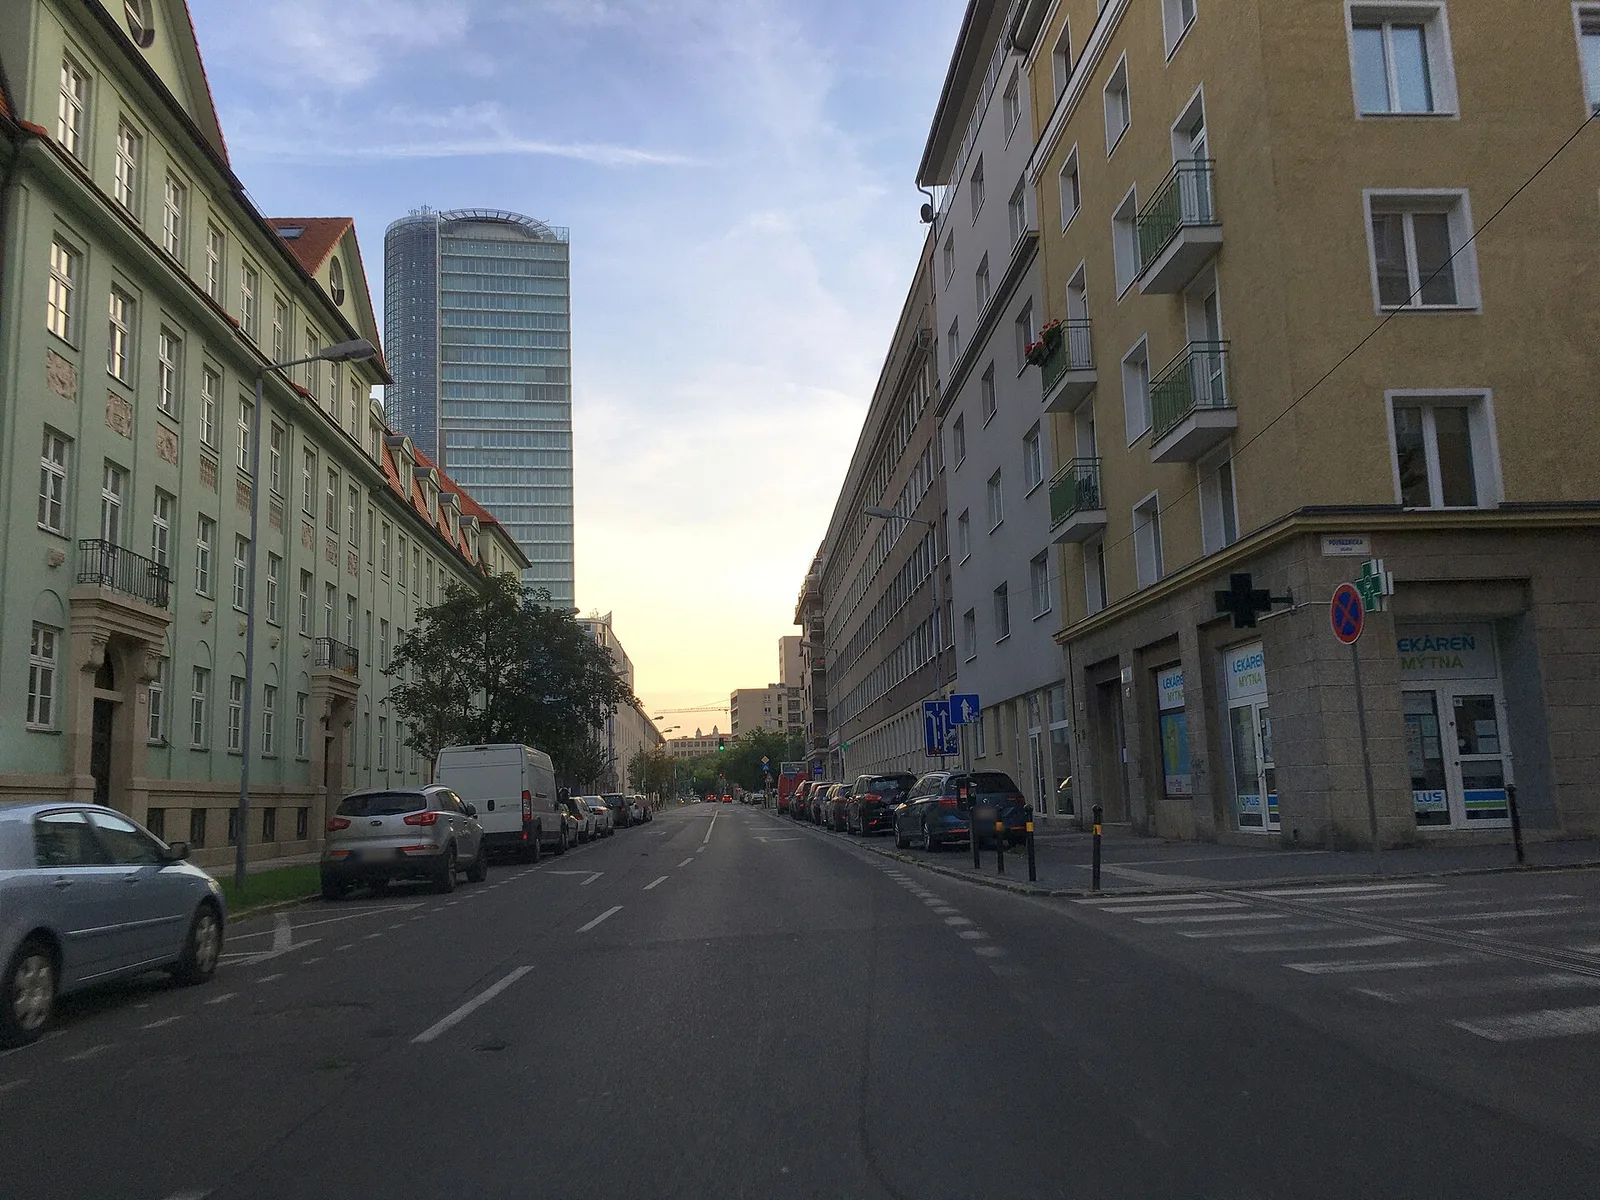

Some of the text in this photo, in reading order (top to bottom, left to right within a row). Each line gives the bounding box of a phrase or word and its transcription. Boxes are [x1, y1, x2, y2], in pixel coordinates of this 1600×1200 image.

[1397, 633, 1475, 652] EKÁREŇ
[1401, 654, 1464, 669] MÝTNA
[1414, 791, 1443, 803] LUS
